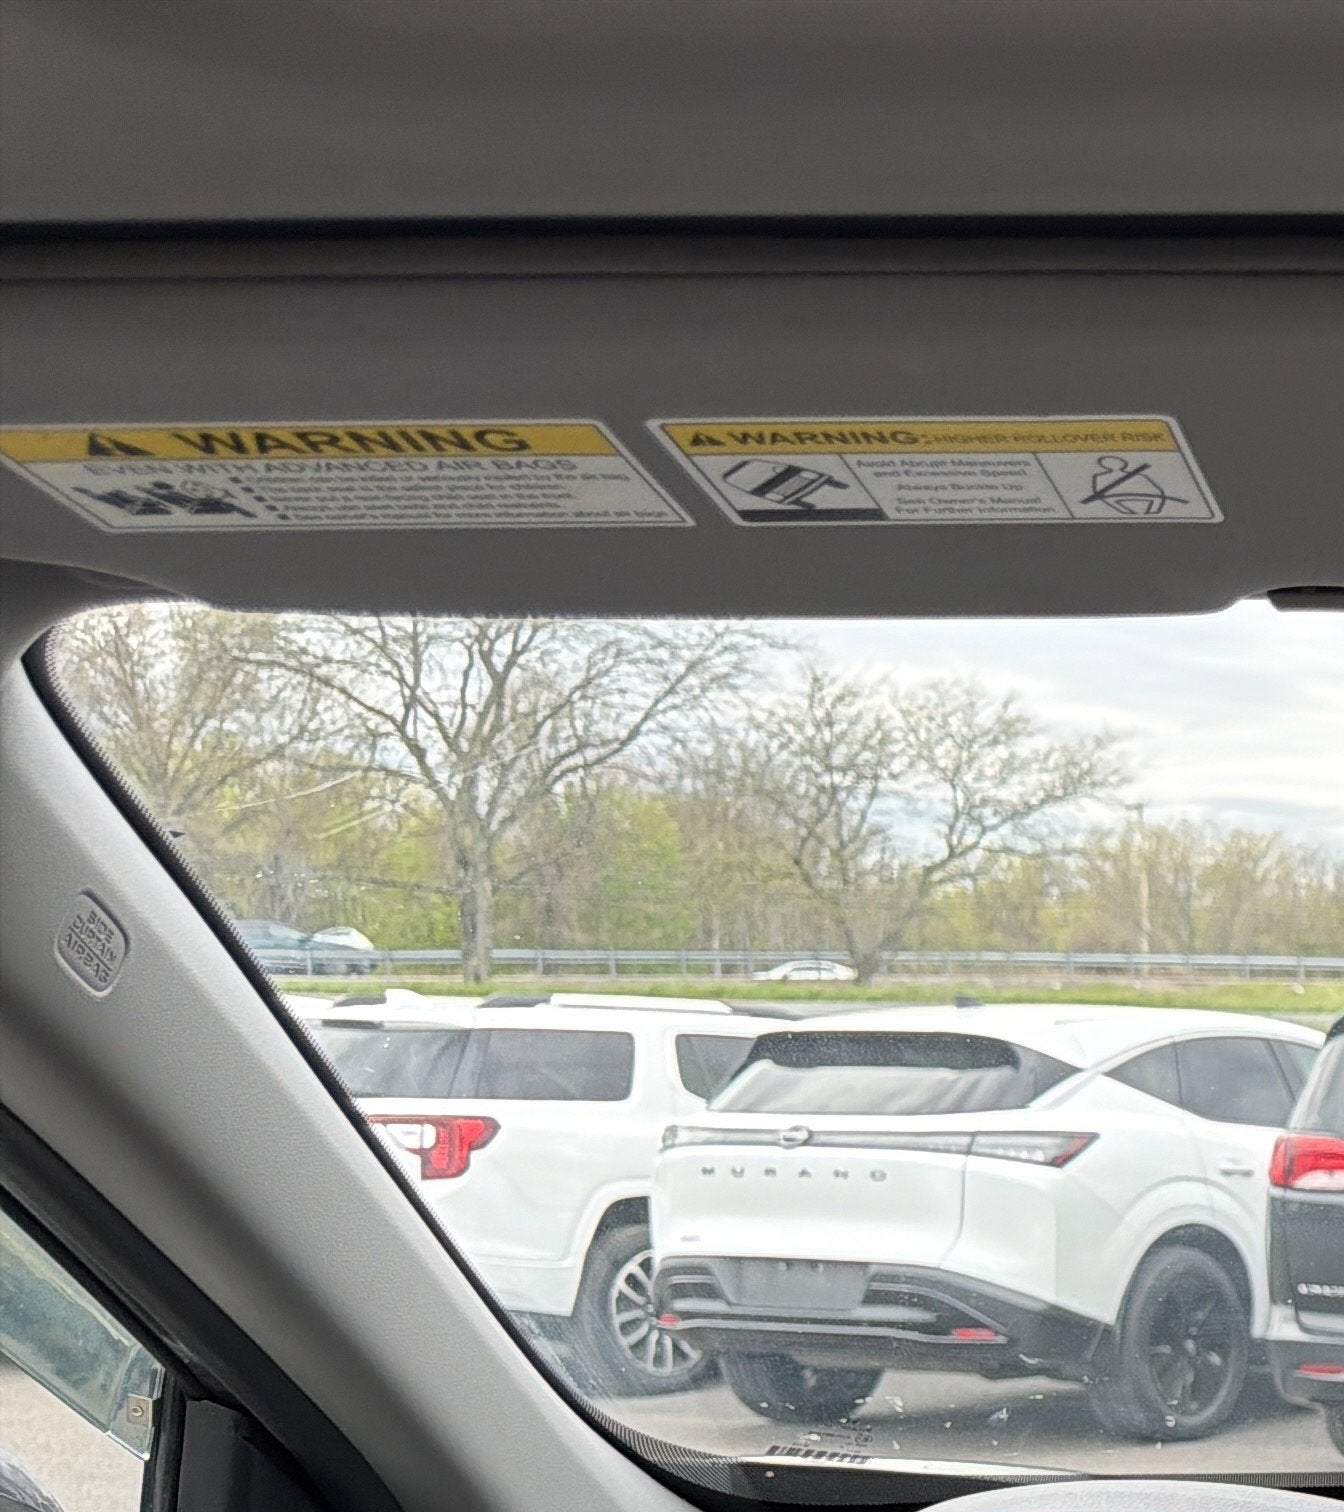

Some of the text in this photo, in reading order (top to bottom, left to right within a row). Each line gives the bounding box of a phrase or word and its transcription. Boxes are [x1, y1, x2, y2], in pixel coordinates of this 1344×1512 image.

[171, 428, 532, 455] WARNING
[1011, 432, 1116, 443] ROLLOVER
[1120, 431, 1165, 442] RISK
[83, 459, 577, 476] EVEN WITH ADVANCED AIR BAGS
[700, 1165, 888, 1183] MURANO
